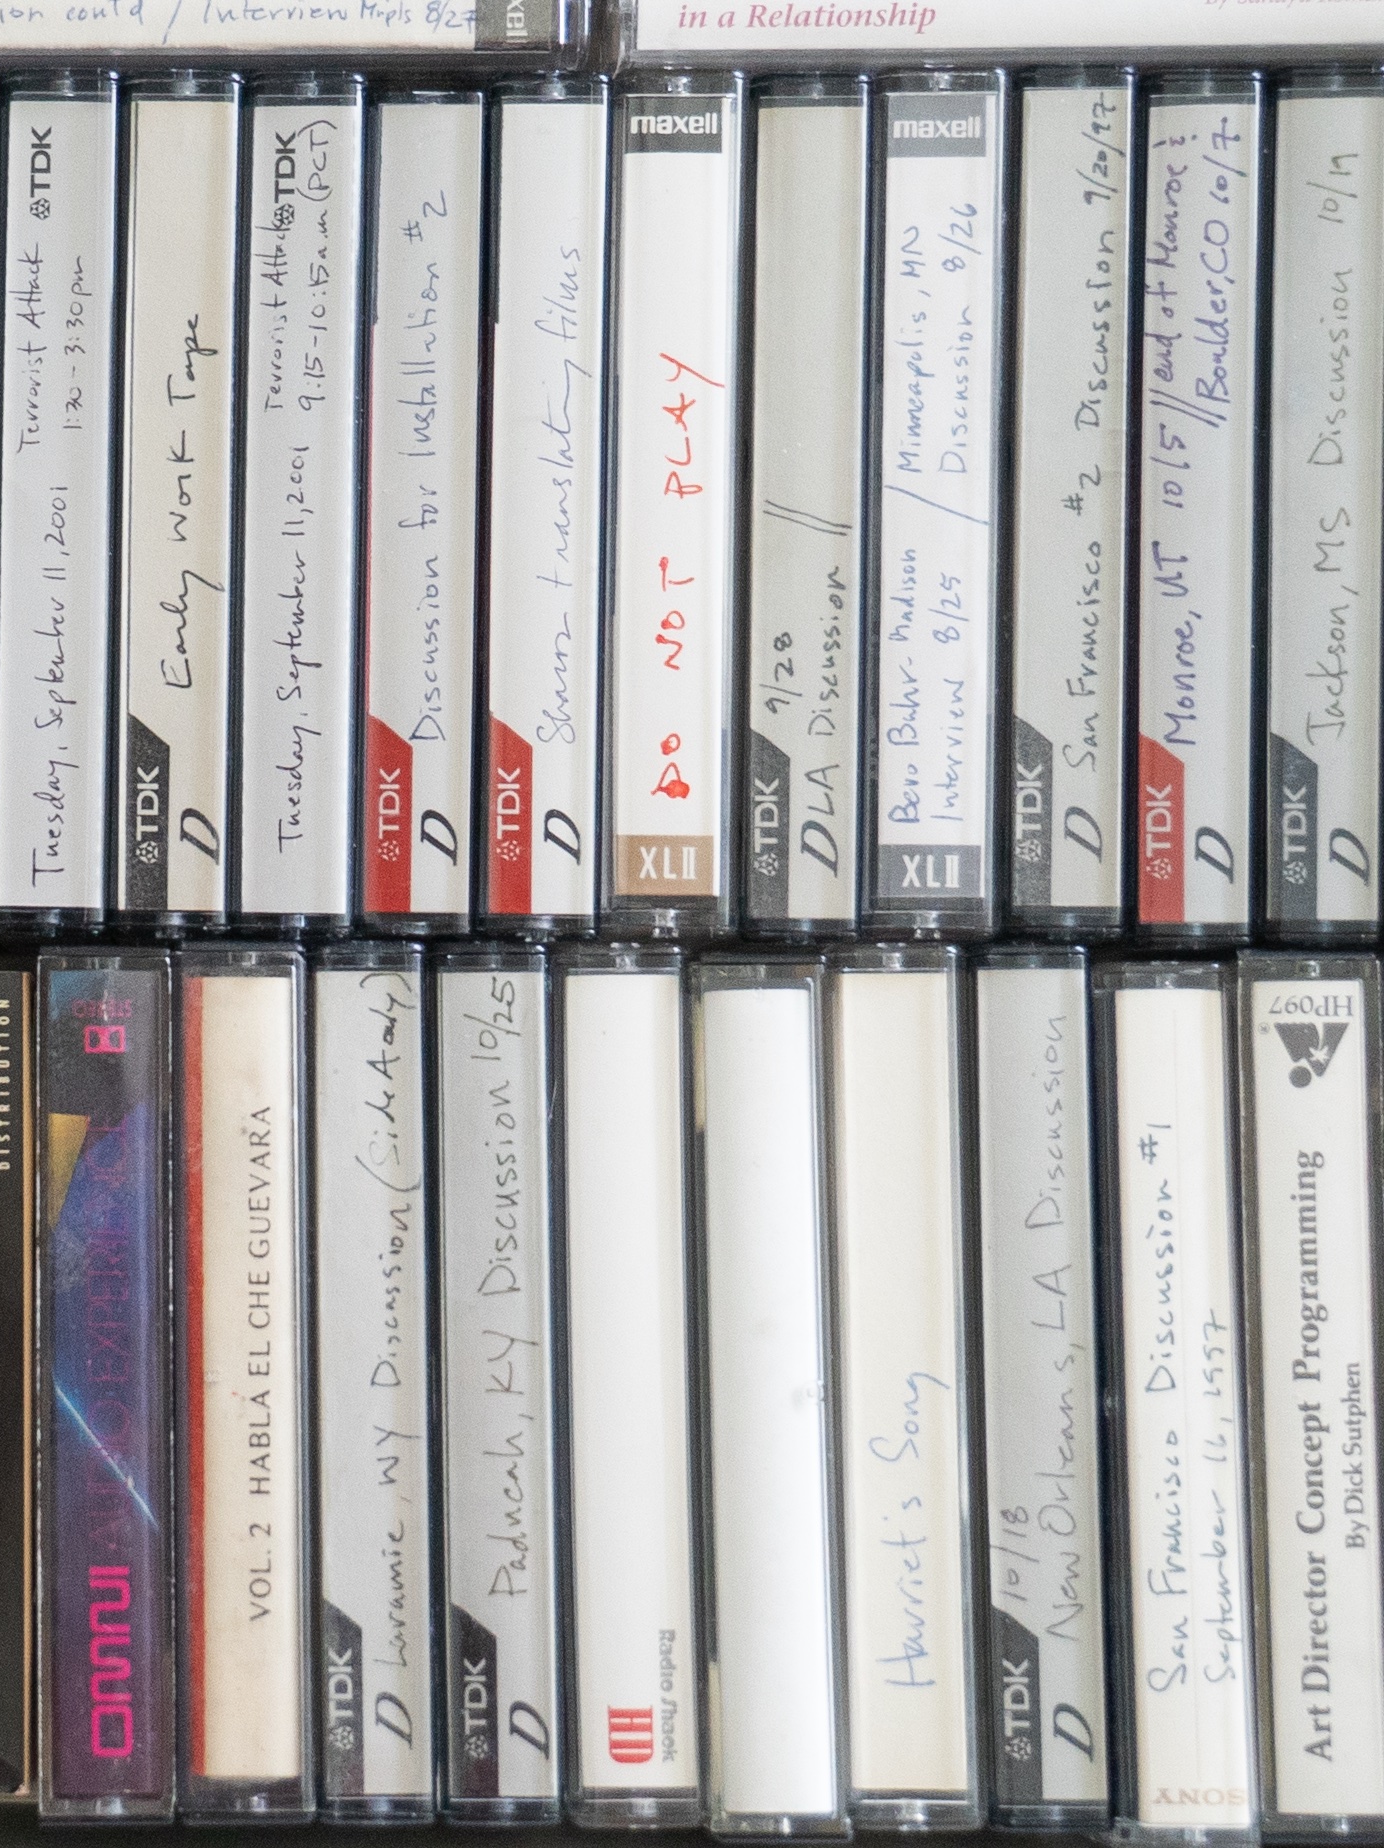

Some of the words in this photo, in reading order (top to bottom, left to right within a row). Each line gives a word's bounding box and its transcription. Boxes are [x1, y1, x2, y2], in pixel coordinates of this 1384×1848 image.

[677, 4, 706, 30] in
[717, 8, 736, 29] a
[745, 2, 936, 36] Relationship
[29, 126, 54, 199] TDK
[630, 111, 718, 136] maxell
[892, 117, 982, 140] maxell
[254, 218, 291, 287] Attack
[938, 201, 983, 273] 8/26
[8, 241, 46, 330] Attack
[16, 340, 47, 454] Terrorist
[167, 313, 219, 406] Tape
[260, 294, 289, 413] Terrorist
[398, 261, 438, 459] Installation
[938, 305, 973, 474] Discussion
[1306, 267, 1354, 466] Discussion
[658, 352, 725, 500] PLAY
[168, 430, 197, 544] Work
[399, 483, 438, 531] for
[1314, 505, 1352, 573] MS
[160, 569, 225, 690] Early
[409, 553, 447, 742] Discussion
[655, 555, 696, 671] NOT
[808, 565, 848, 738] Discussion
[928, 570, 970, 643] 8/25
[1305, 584, 1359, 747] Jackson,
[806, 762, 839, 817] LA
[929, 679, 965, 820] Interview
[378, 767, 402, 844] TDK
[1145, 783, 1173, 858] TDK
[463, 976, 521, 1061] 10/25
[1268, 993, 1356, 1016] HP097
[1024, 1014, 1068, 1231] Discussion
[246, 1105, 272, 1259] GUEVARA
[477, 1079, 521, 1296] Discussion
[247, 1270, 272, 1330] CHE
[1032, 1264, 1073, 1331] LA
[1143, 1179, 1178, 1393] Discussion
[1290, 1148, 1329, 1383] Programming
[249, 1341, 271, 1377] EL
[483, 1330, 539, 1395] KY
[248, 1389, 272, 1495] HABLA
[868, 1372, 951, 1462] Song
[1036, 1343, 1086, 1537] Orleans,
[1341, 1360, 1368, 1456] Sutphen
[483, 1412, 534, 1597] Paducah,
[1147, 1428, 1188, 1595] Francisco
[1295, 1400, 1330, 1536] Concept
[1344, 1461, 1366, 1514] Dick
[249, 1522, 272, 1538] 2
[990, 1505, 1038, 1602] 10/18
[1346, 1521, 1369, 1549] By
[249, 1550, 272, 1622] VOL.
[875, 1496, 936, 1688] Harriet's
[1045, 1551, 1084, 1641] New
[1300, 1550, 1331, 1693] Director
[89, 1565, 134, 1758] OMNI
[658, 1628, 676, 1692] Radio
[1003, 1659, 1030, 1737] TDK
[1146, 1616, 1190, 1693] San
[661, 1697, 678, 1763] Shack
[1053, 1701, 1093, 1762] D
[1303, 1703, 1334, 1763] Art
[1153, 1788, 1247, 1806] SONY
